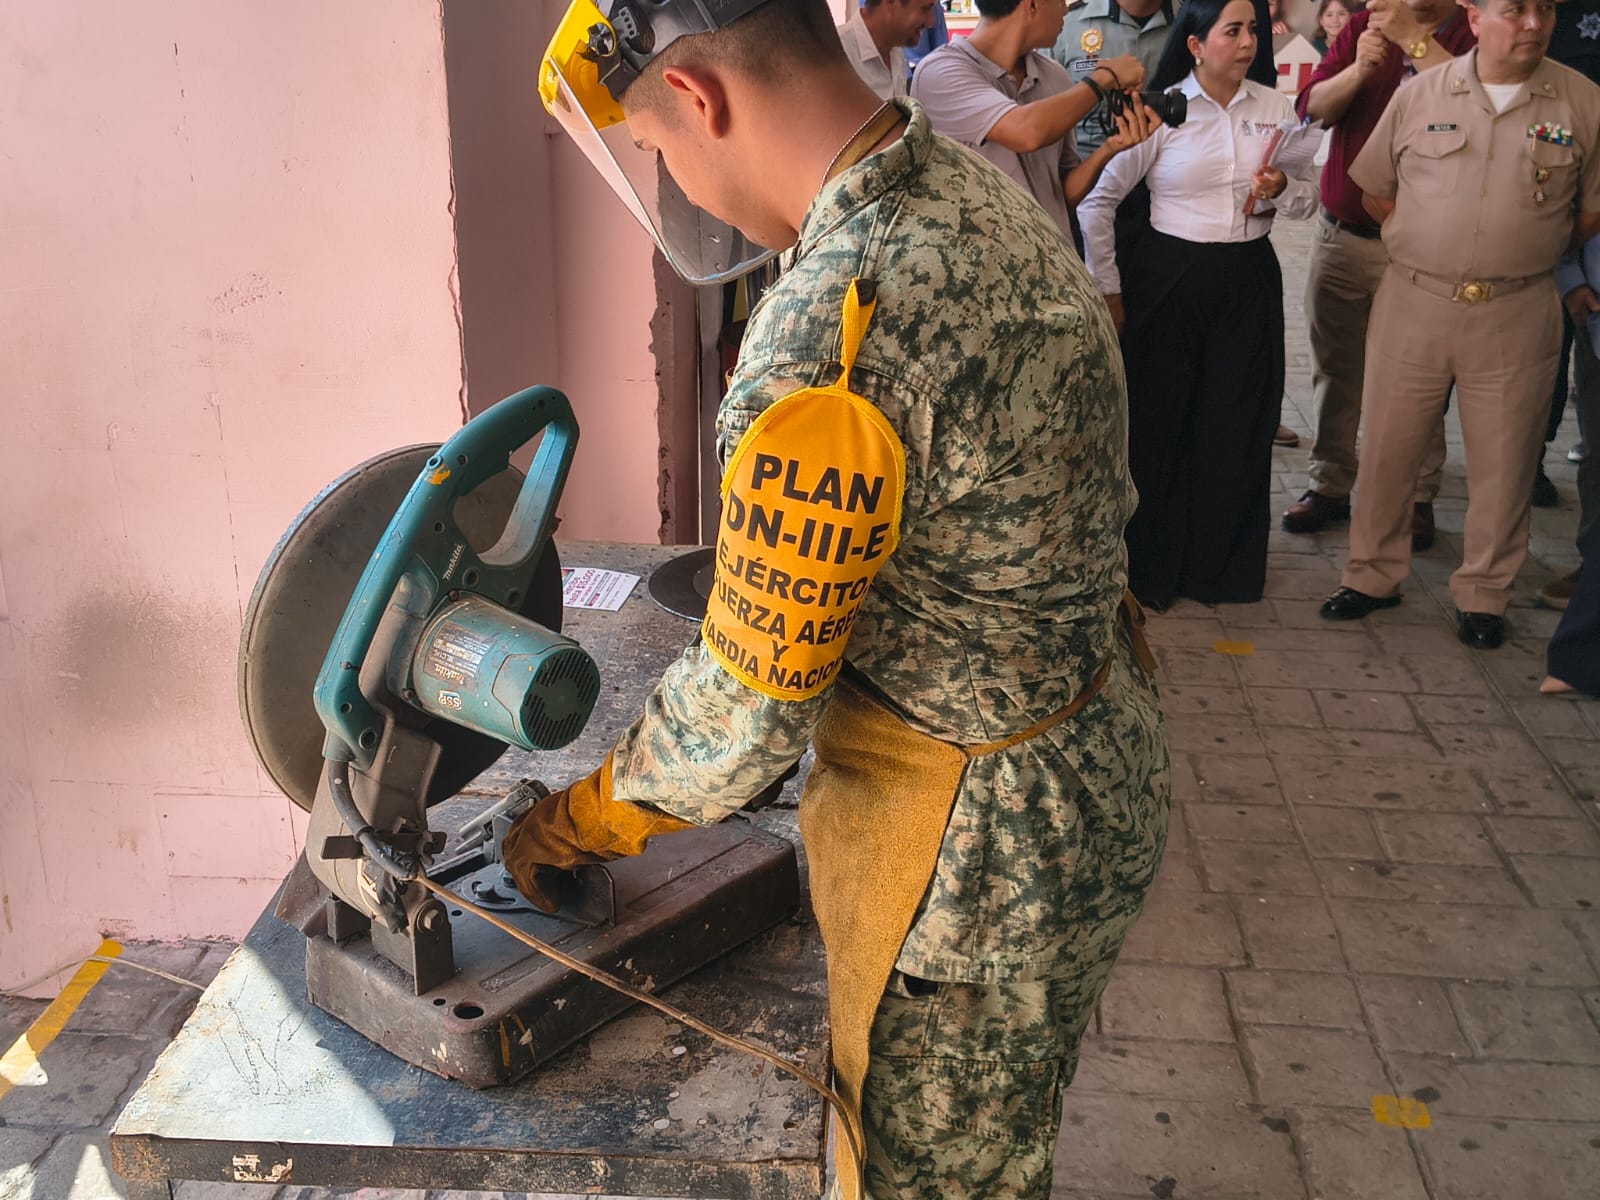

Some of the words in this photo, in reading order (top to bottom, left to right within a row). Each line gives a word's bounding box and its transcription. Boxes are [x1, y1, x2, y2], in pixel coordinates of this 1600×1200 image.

[751, 452, 885, 514] PLAN
[726, 489, 890, 565] DN-III-E
[772, 640, 790, 663] Y
